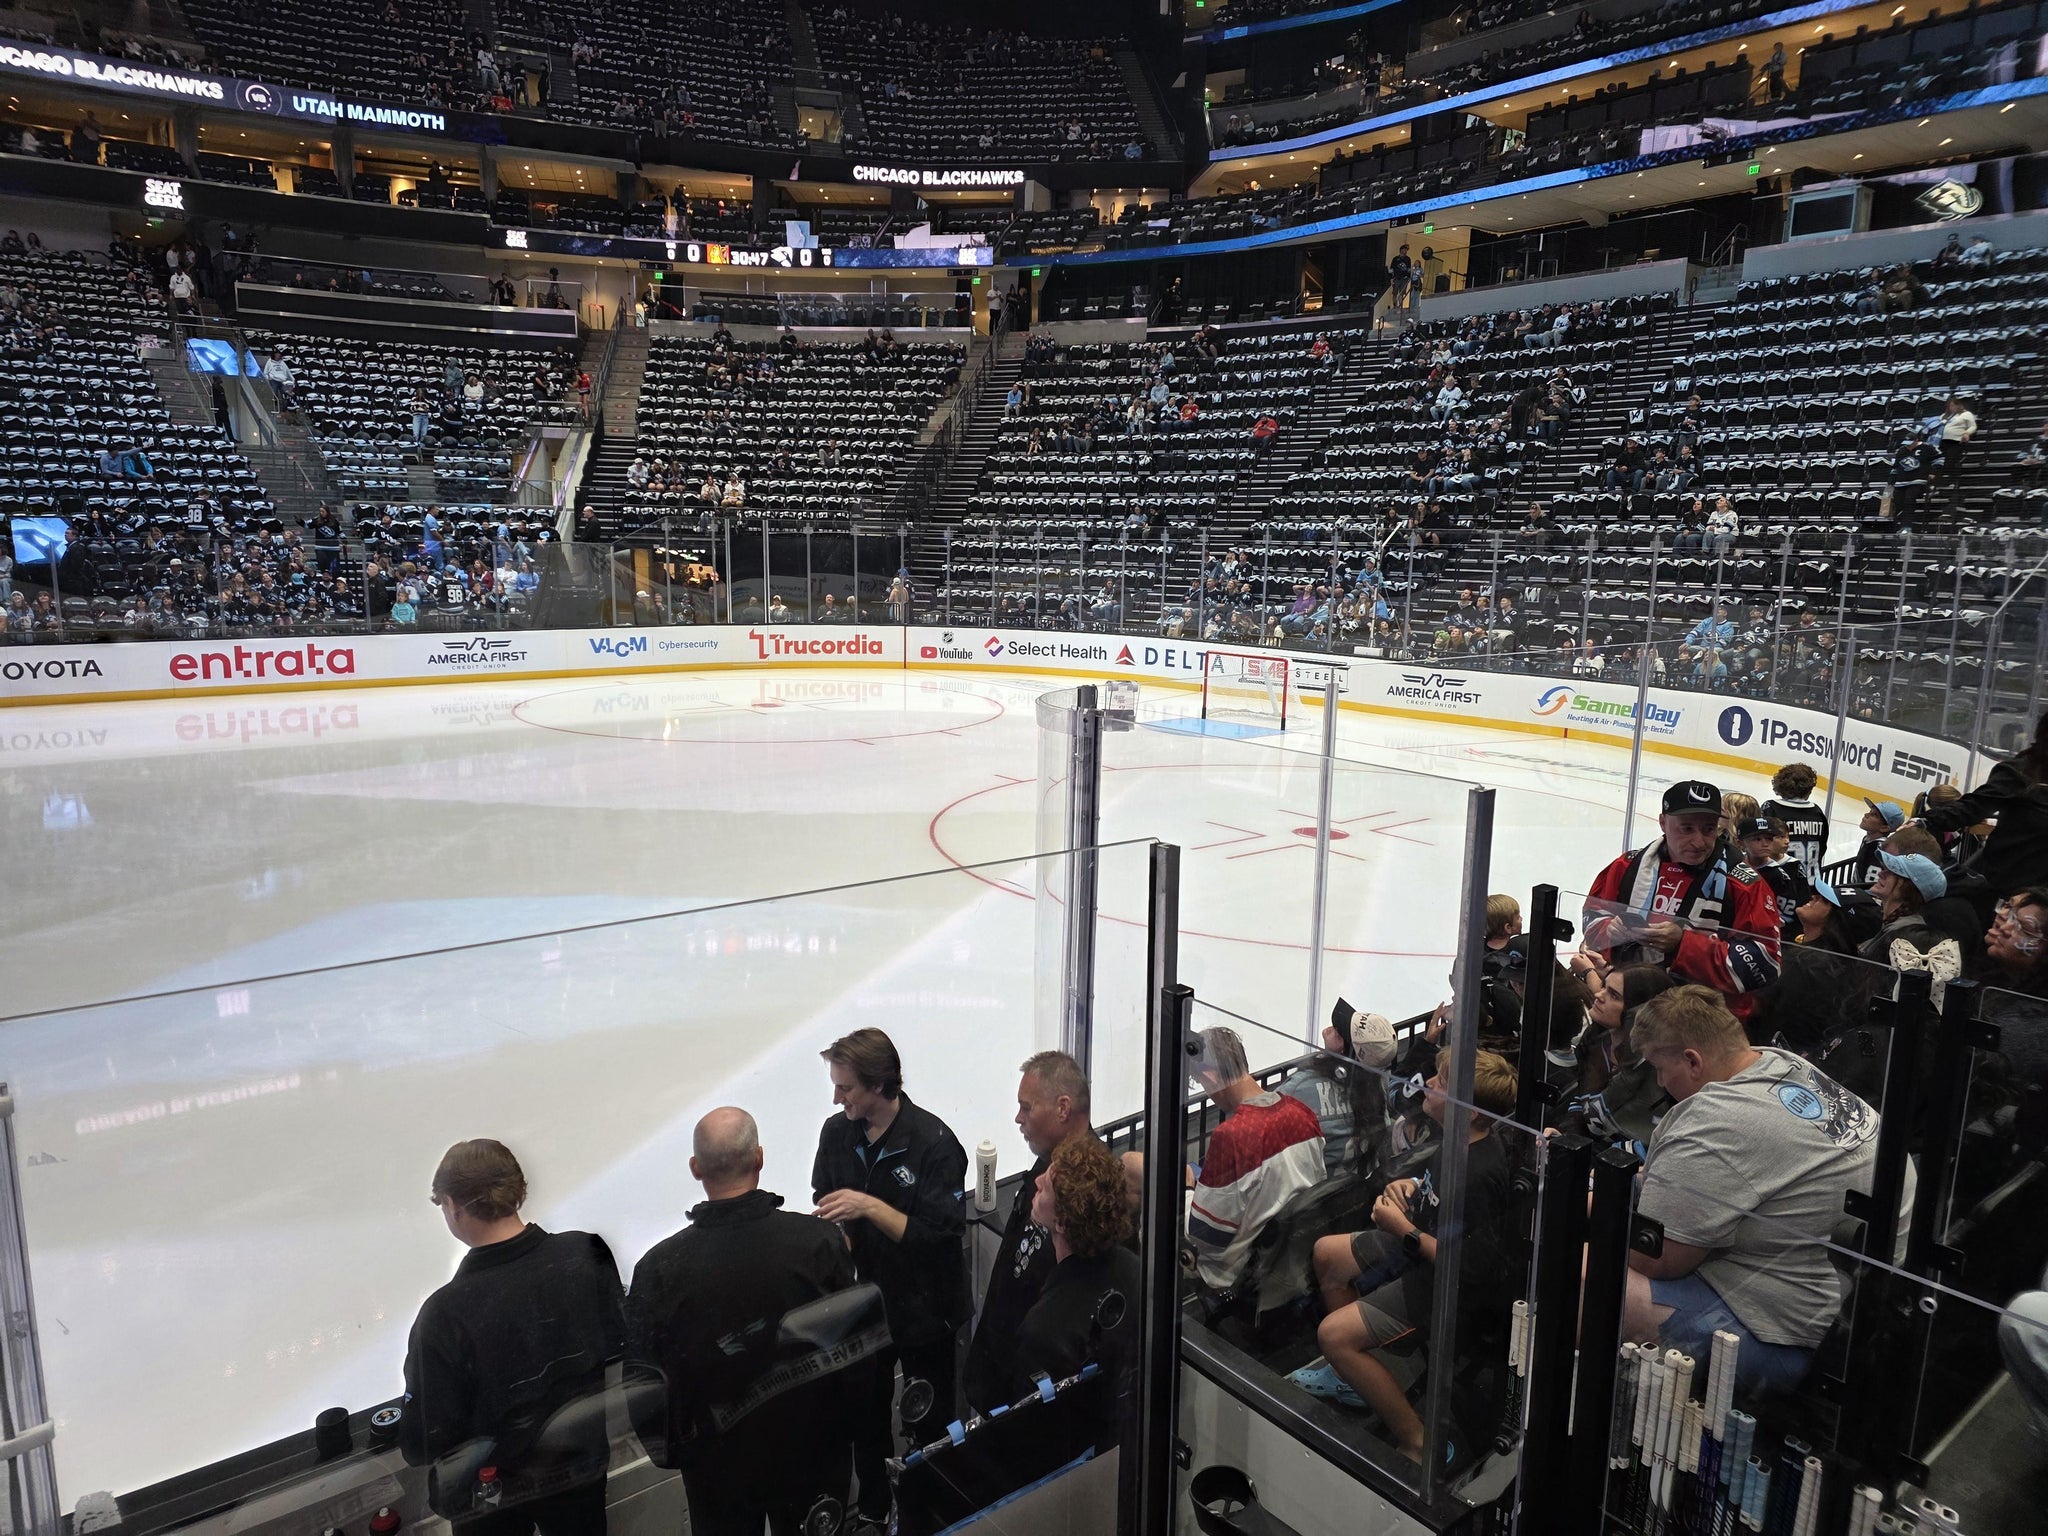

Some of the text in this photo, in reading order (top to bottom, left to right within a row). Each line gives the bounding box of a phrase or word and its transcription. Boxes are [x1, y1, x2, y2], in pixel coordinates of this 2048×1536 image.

[73, 58, 224, 100] BLACKHAWKS
[292, 96, 445, 130] UTAH MAMMOTH
[853, 165, 1025, 185] CHICAGO BLACKHAWKS
[145, 178, 181, 195] SEAT
[144, 192, 185, 210] GEEK
[687, 244, 812, 267] 0 30:47 0
[447, 589, 463, 604] 98
[588, 636, 647, 658] VLCM
[658, 639, 719, 652] Cybersecurity
[769, 634, 883, 655] Trucordia
[939, 647, 973, 660] YouTube
[1008, 641, 1107, 661] Select Health
[169, 643, 355, 681] entrata
[427, 651, 528, 665] AMERICA FIRST
[1144, 647, 1225, 674] DELTA
[0, 659, 103, 681] OYOTA
[1387, 685, 1482, 704] AMERICA FIRST
[1566, 713, 1594, 725] Heating
[1650, 725, 1675, 736] Electrical
[1760, 718, 1882, 772] 1Password
[1482, 750, 1673, 784] CROWDSTR
[1891, 750, 1951, 786] ESPN
[1785, 821, 1824, 836] CHMIDT
[1776, 894, 1797, 916] 92
[1359, 1013, 1370, 1030] TAH
[1787, 1090, 1815, 1114] UTAH
[982, 1164, 990, 1203] BODYARMOR
